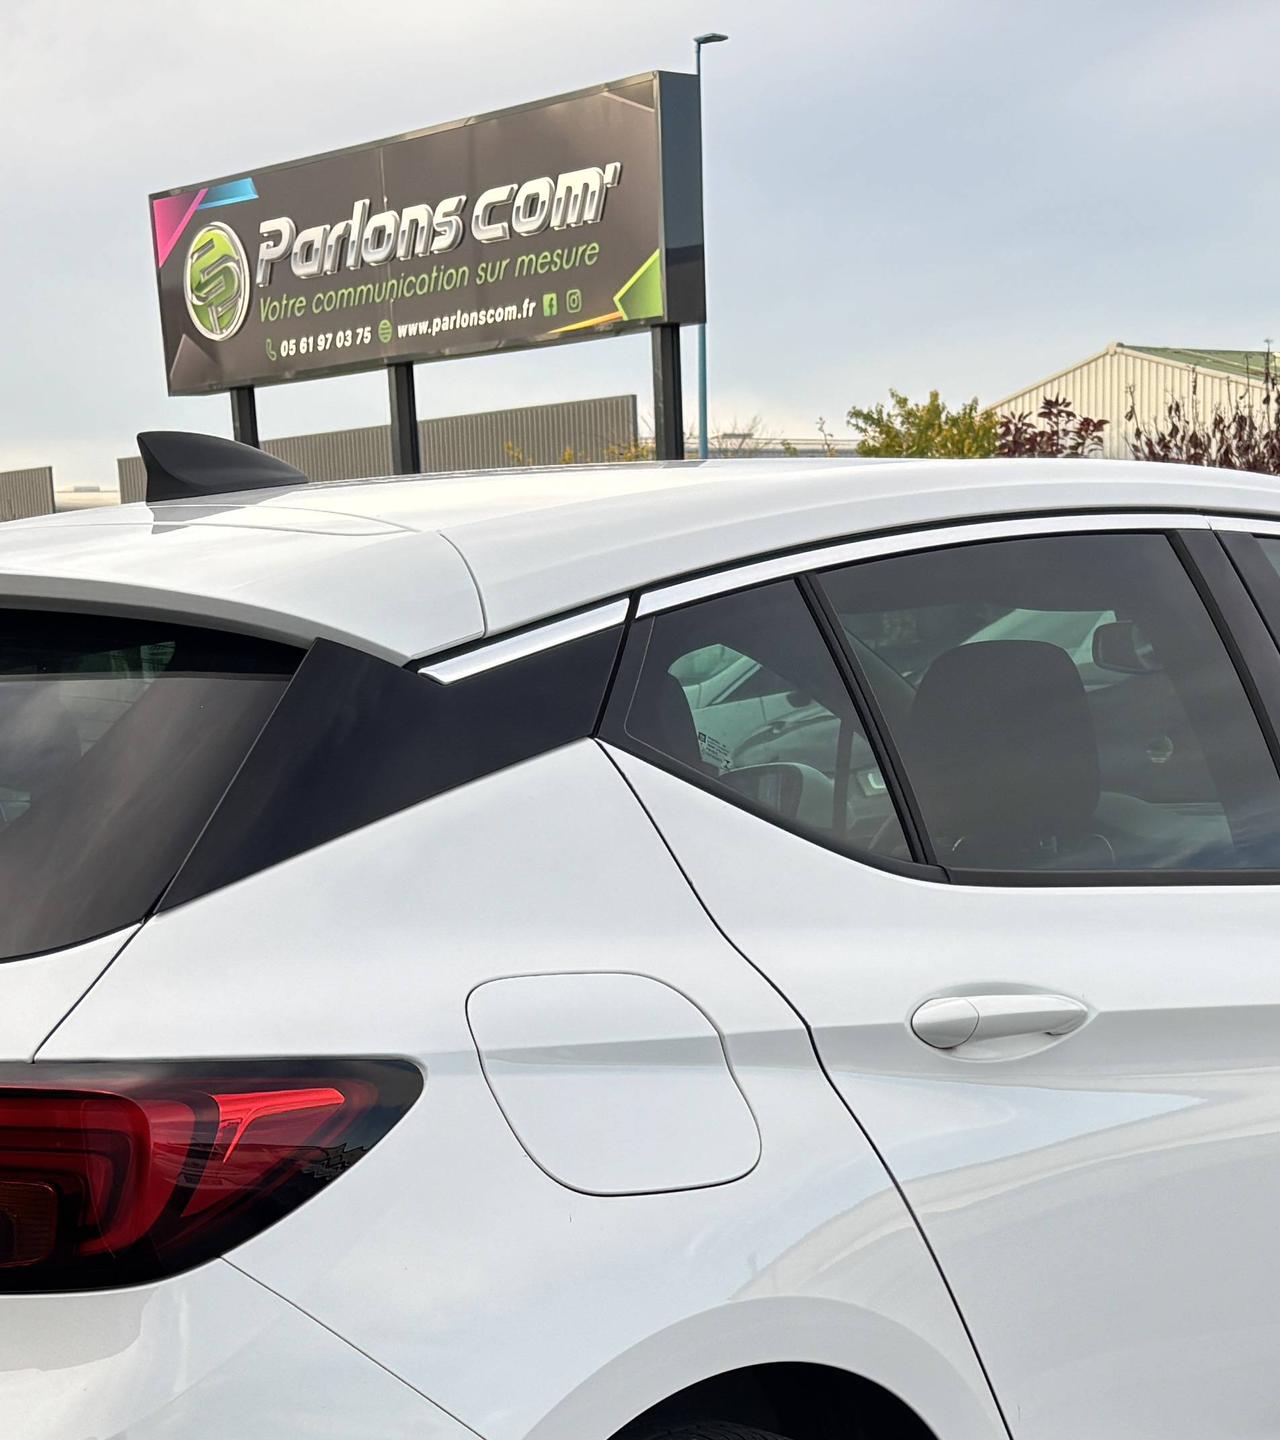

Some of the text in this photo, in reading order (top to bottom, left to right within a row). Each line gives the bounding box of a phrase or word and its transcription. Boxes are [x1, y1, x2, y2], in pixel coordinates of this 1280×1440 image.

[256, 194, 467, 287] Parlons
[260, 242, 600, 322] Votre communication sur mesure
[280, 326, 372, 357] 05 61 97 03 75
[397, 298, 536, 339] www.parlonscom.fr
